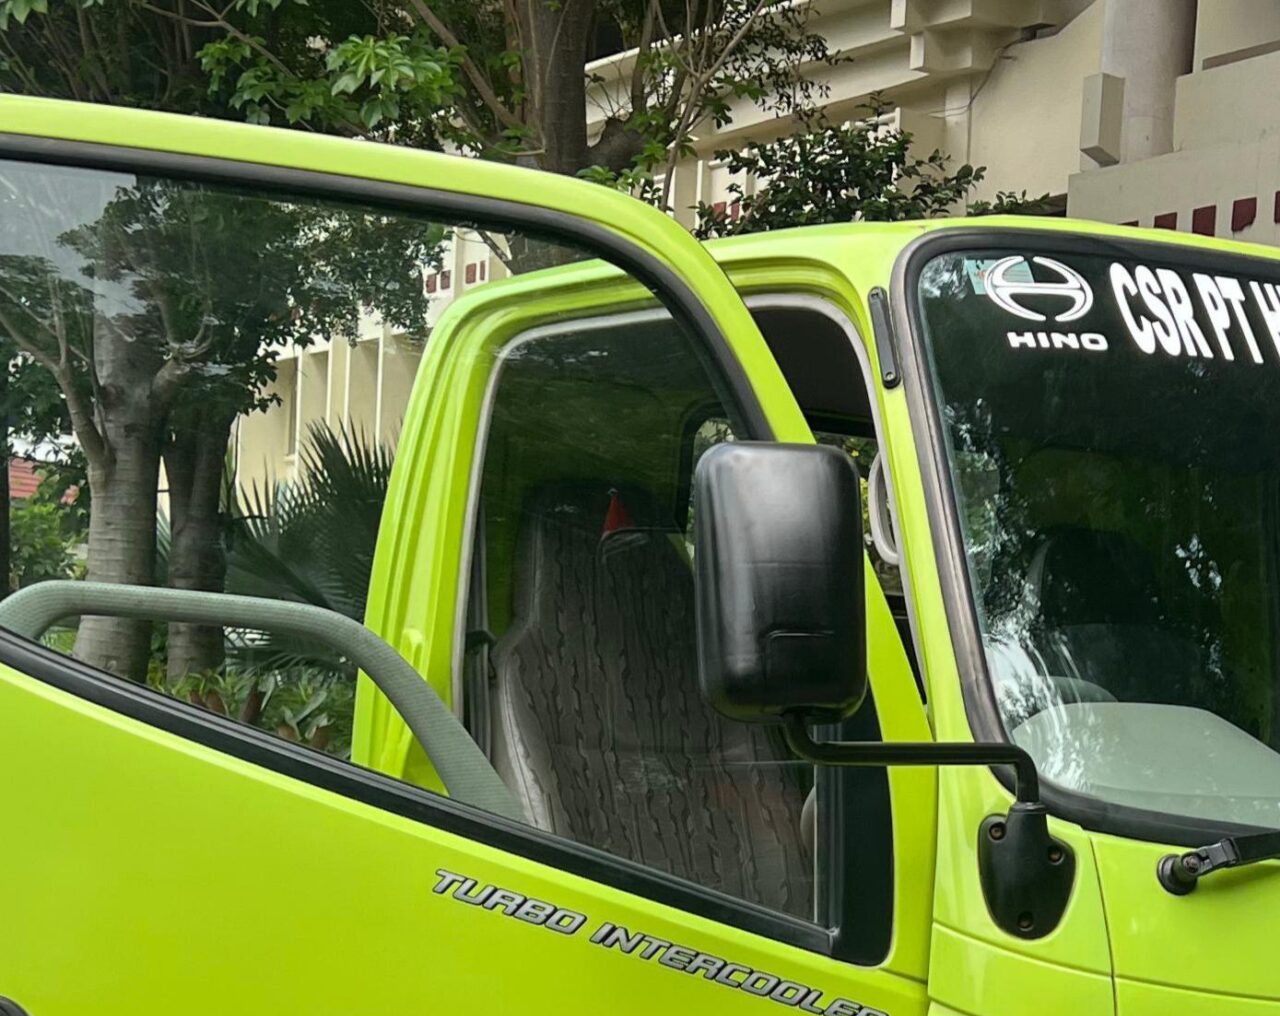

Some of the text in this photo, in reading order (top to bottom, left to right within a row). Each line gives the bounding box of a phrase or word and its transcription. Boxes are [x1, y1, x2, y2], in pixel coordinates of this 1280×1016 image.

[1006, 331, 1109, 352] HINO
[1109, 261, 1215, 360] CSR
[1192, 272, 1265, 365] PT
[432, 868, 588, 936] TURBO
